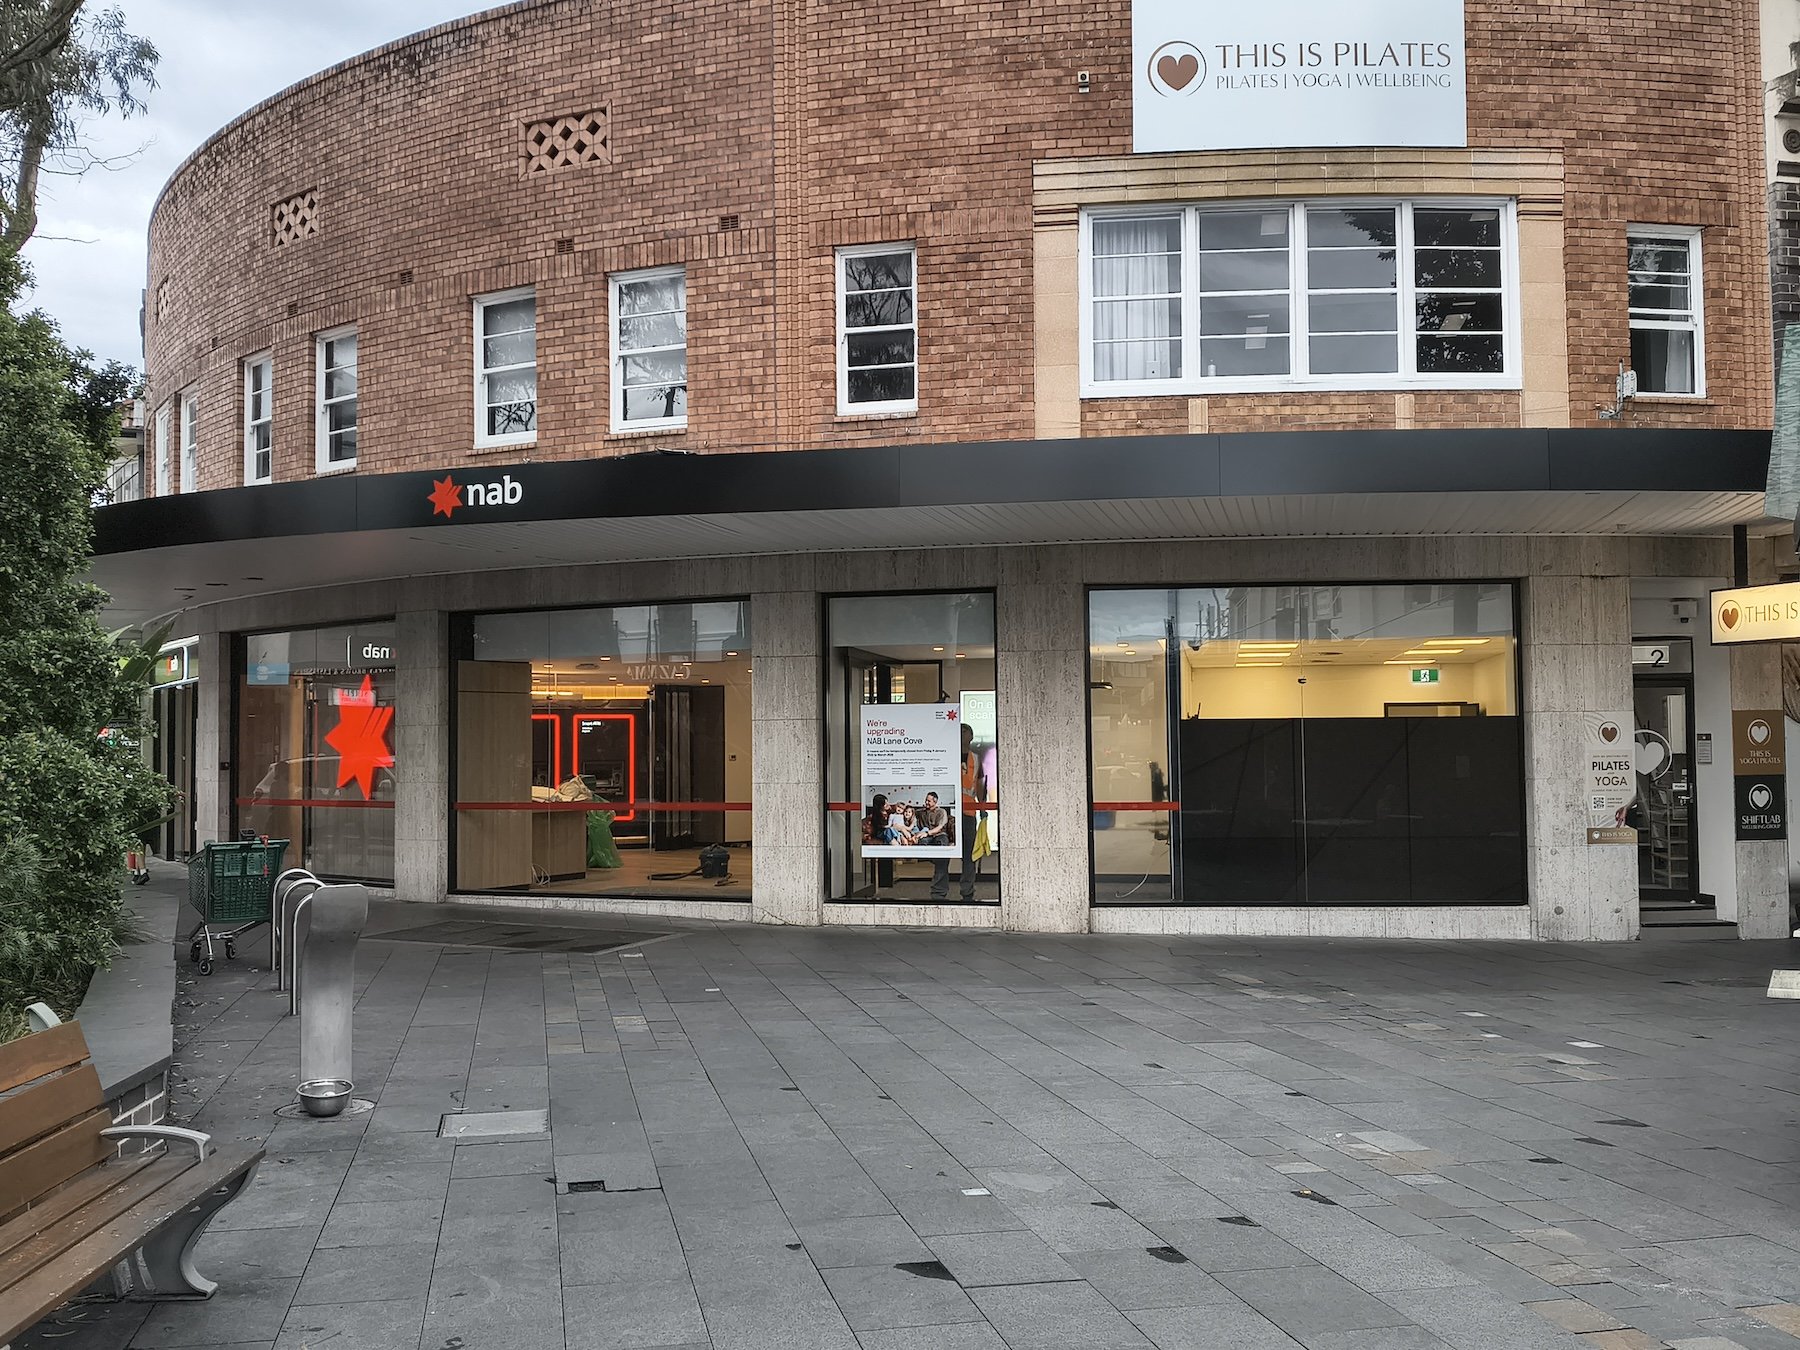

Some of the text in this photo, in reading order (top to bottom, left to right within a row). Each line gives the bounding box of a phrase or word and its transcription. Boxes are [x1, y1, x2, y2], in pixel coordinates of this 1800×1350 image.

[1215, 42, 1451, 69] THIS IS PILATES
[1216, 73, 1279, 89] PILATES
[1292, 72, 1342, 88] YOGA
[1356, 72, 1451, 88] WELLBEING
[466, 475, 523, 506] nab
[1745, 601, 1799, 623] THIS IS
[1651, 649, 1664, 668] 2
[969, 699, 984, 709] On
[866, 719, 888, 727] We're
[866, 727, 906, 737] upgrading
[866, 737, 923, 745] NAB Lane Cove
[1750, 750, 1764, 758] THIS
[1592, 760, 1630, 771] PILATES
[1594, 776, 1628, 786] YOGA
[1741, 814, 1781, 825] SHIFTLAB
